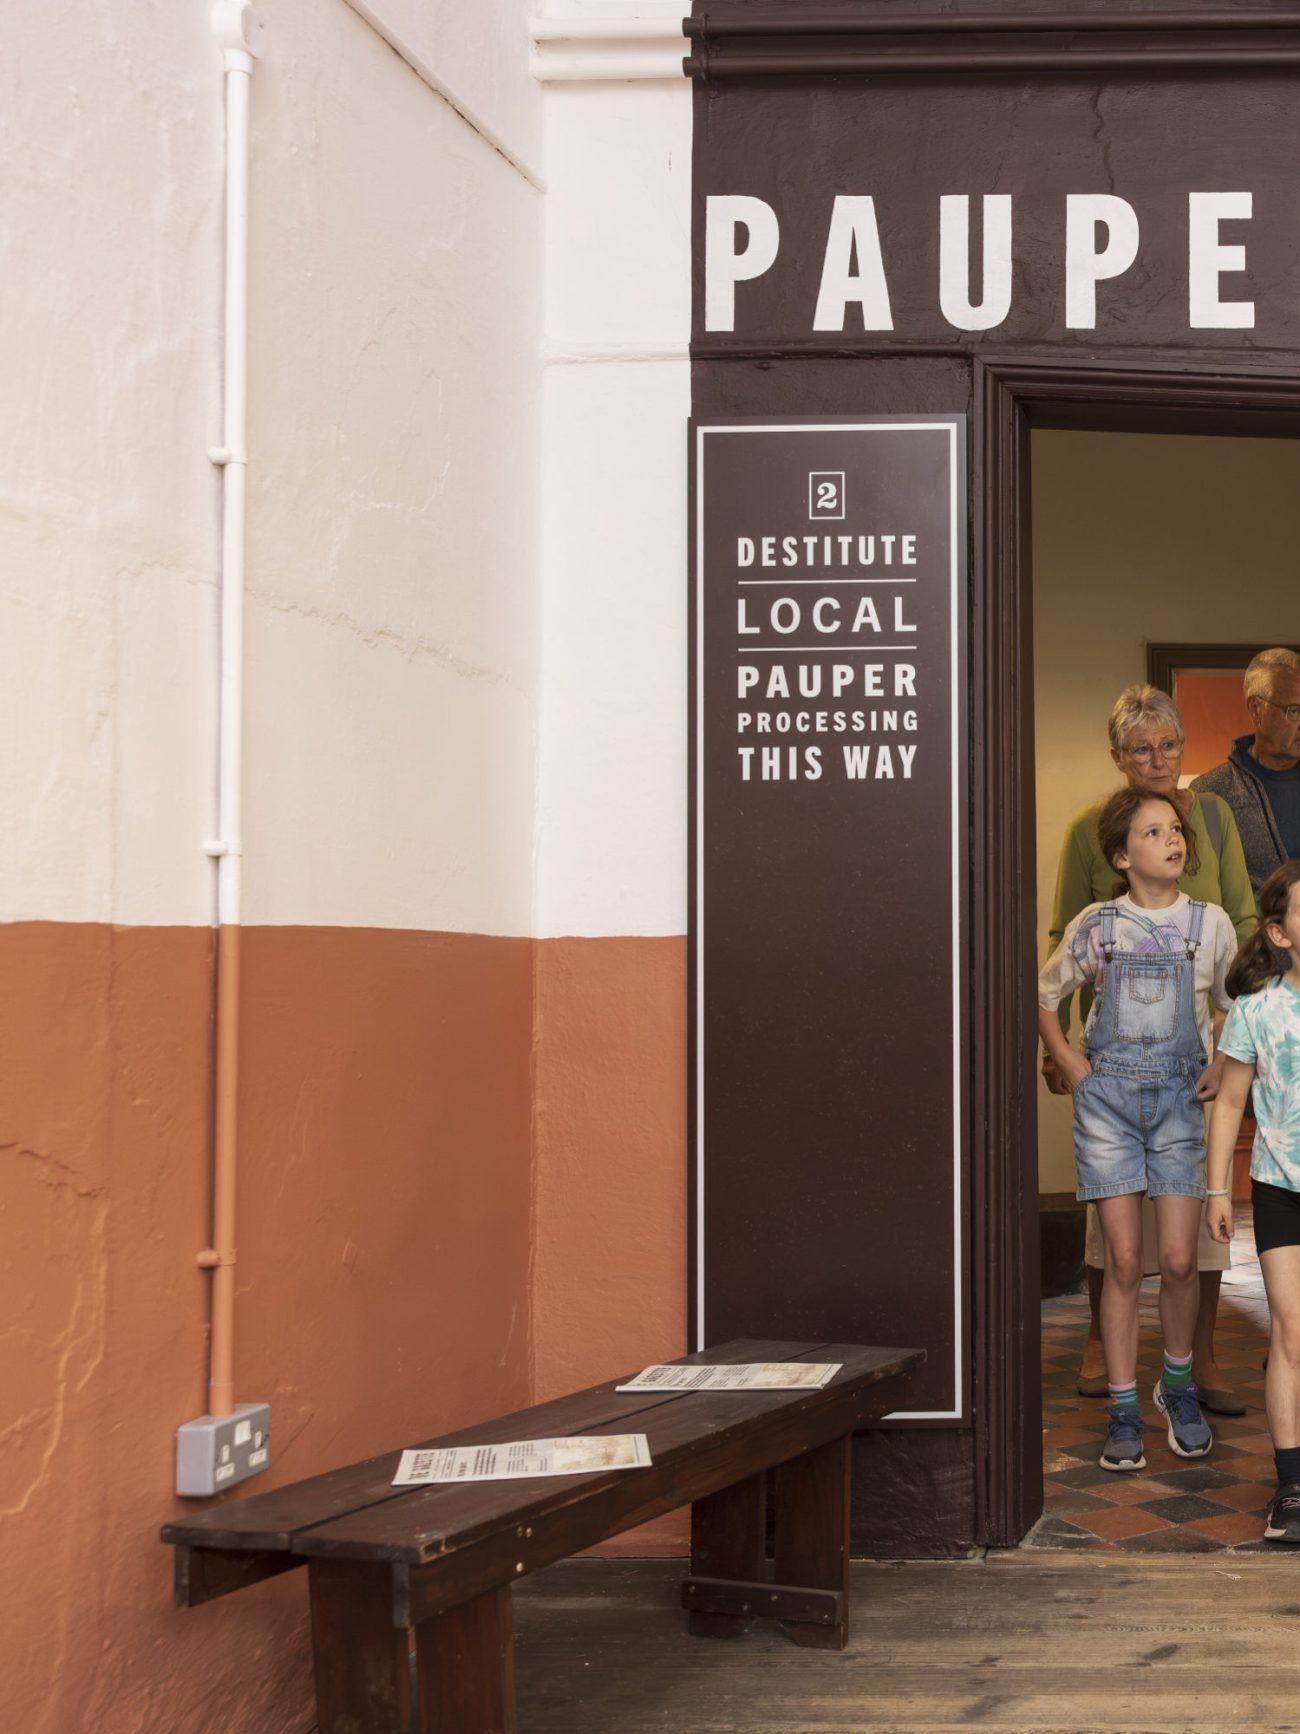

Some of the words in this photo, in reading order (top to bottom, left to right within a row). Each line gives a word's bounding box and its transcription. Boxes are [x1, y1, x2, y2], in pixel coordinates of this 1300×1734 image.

[817, 483, 837, 508] 2
[738, 535, 916, 566] DESTITUTE
[738, 597, 916, 633] LOCAL
[738, 664, 916, 698] PAUPER
[738, 711, 917, 732] PROCESSING
[738, 746, 822, 780] THIS
[843, 745, 916, 779] WAY
